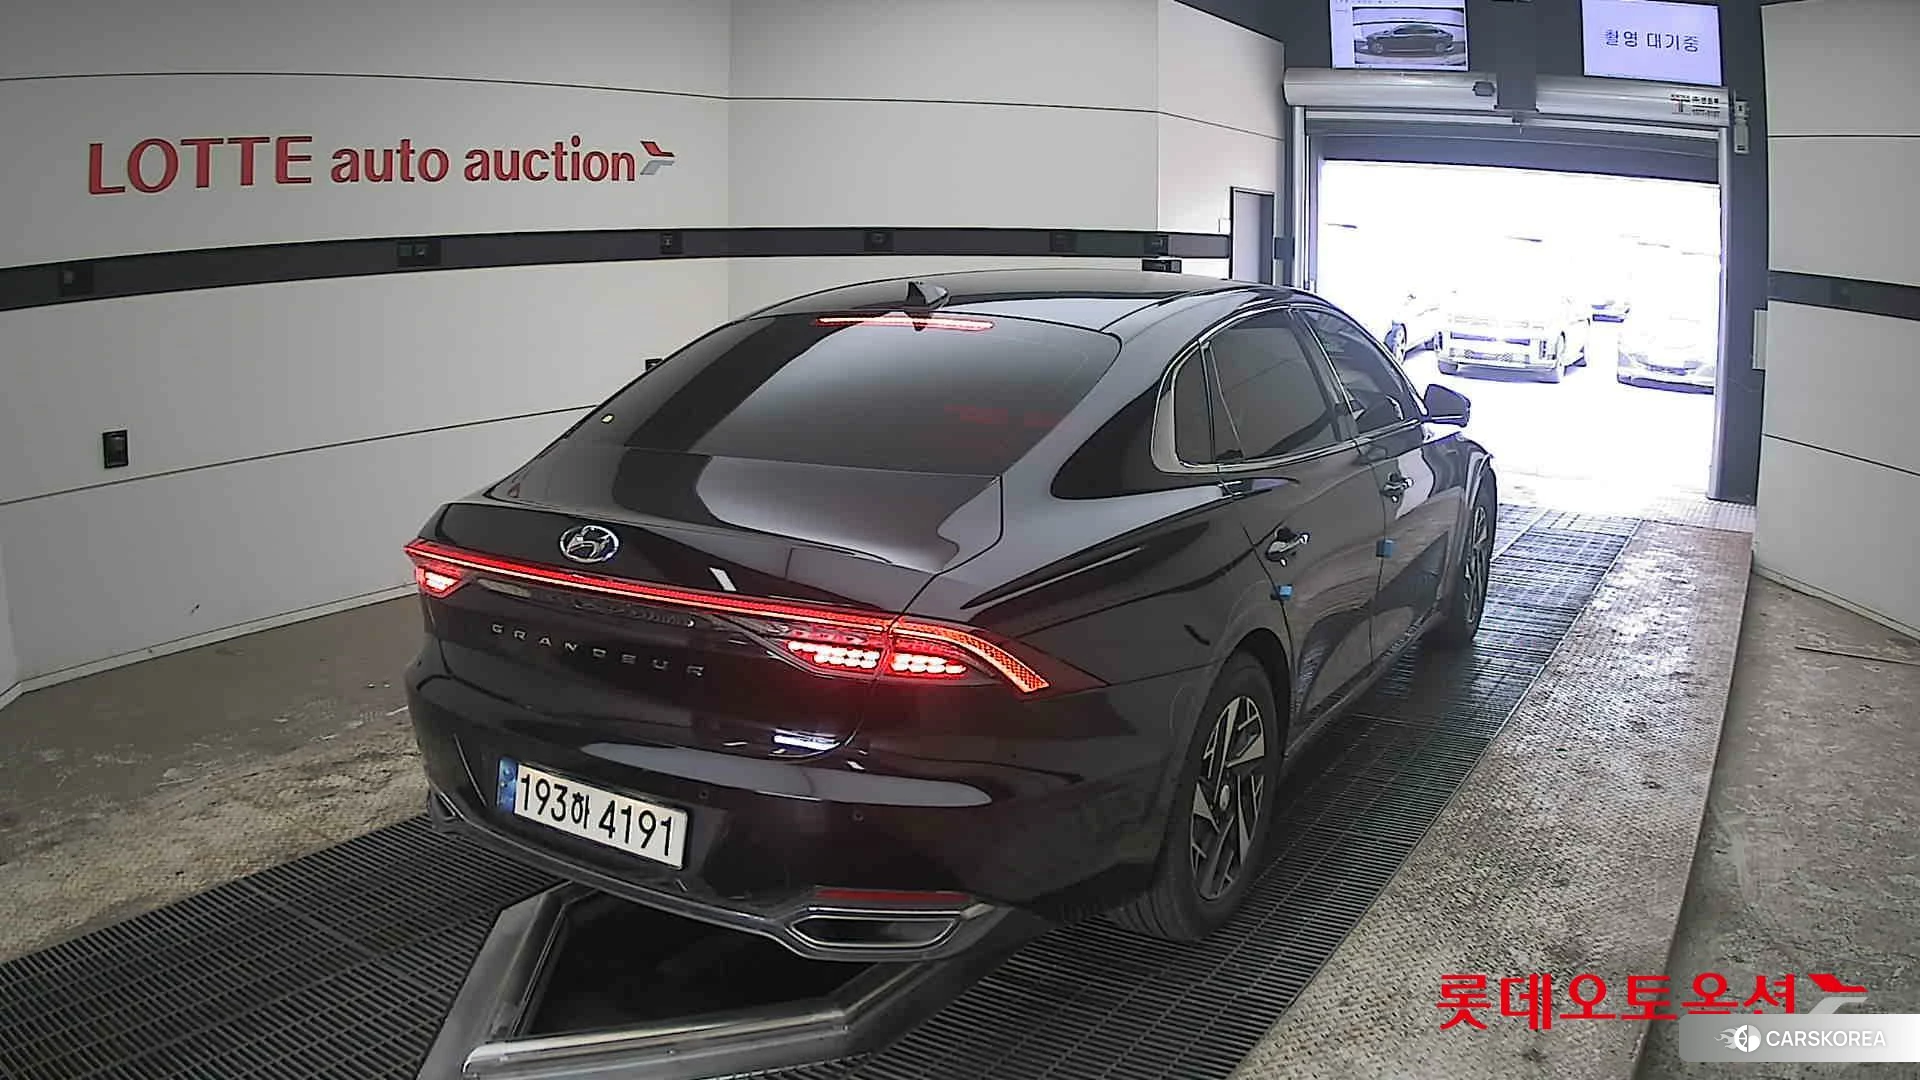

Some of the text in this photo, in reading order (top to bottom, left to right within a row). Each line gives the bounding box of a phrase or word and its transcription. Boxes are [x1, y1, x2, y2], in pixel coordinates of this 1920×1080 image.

[1646, 32, 1699, 53] 대기중
[88, 135, 635, 195] LOTTE auto auction
[491, 622, 705, 677] GRANDEUR
[520, 773, 673, 857] 193하 4191
